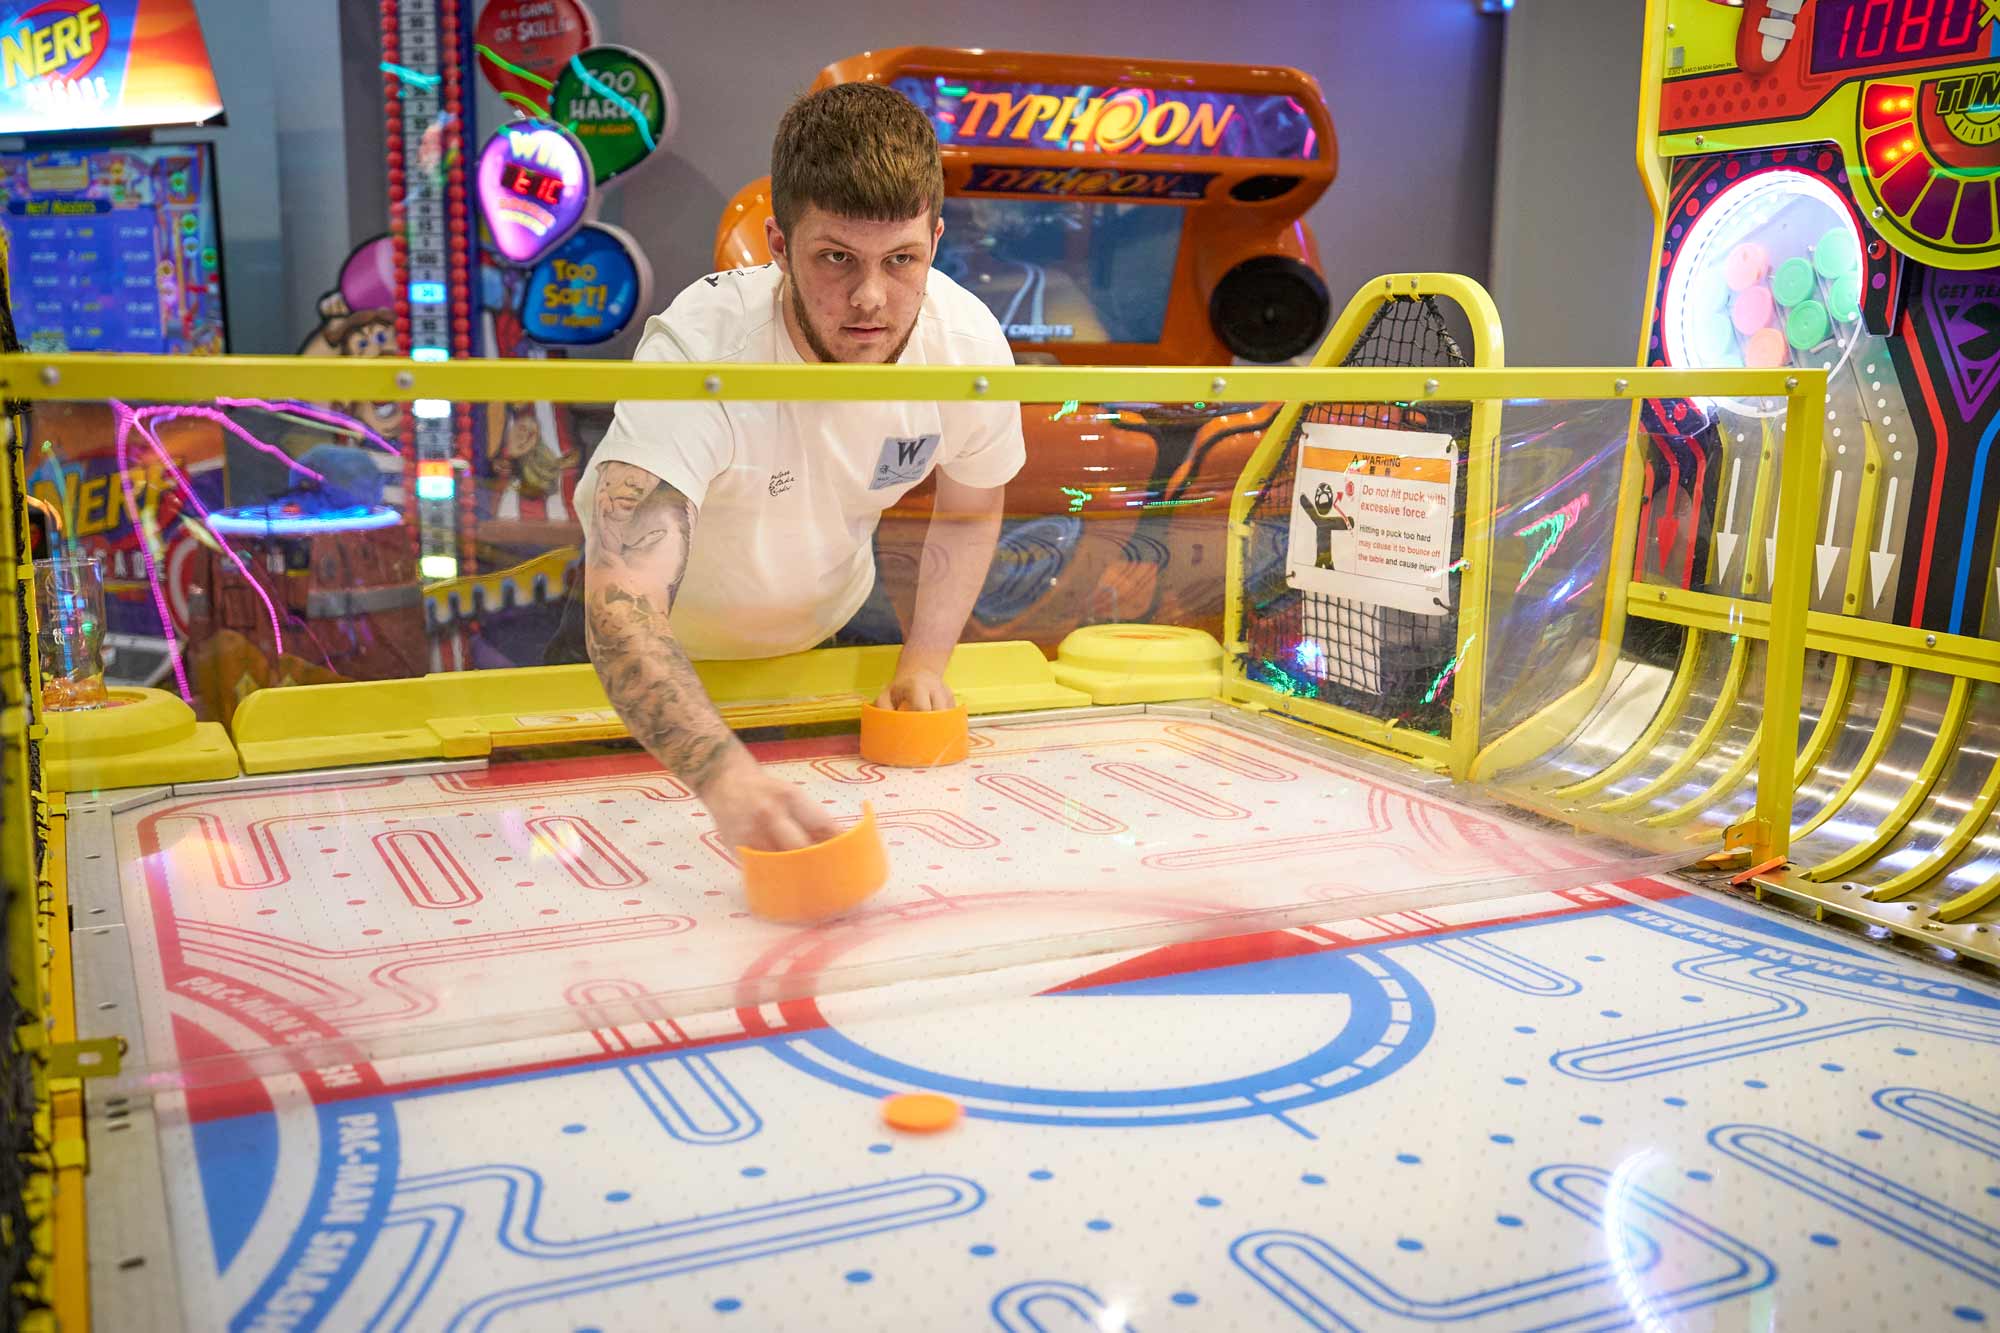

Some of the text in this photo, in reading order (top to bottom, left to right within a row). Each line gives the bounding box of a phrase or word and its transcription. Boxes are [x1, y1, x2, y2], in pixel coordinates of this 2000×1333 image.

[1838, 0, 1977, 60] 1080
[2, 3, 102, 88] NERF
[580, 69, 636, 97] TOO
[569, 91, 650, 120] HARD!
[959, 90, 1235, 150] TYPHOON
[979, 168, 1182, 193] TYPHOON
[552, 260, 597, 281] Too
[1939, 284, 1968, 298] GET
[898, 439, 927, 466] W
[1360, 501, 1400, 516] excessive
[1362, 485, 1447, 506] Do not hit puck with
[1360, 525, 1380, 536] Hitting
[1386, 529, 1401, 539] puck
[1403, 531, 1414, 539] too
[1416, 533, 1431, 542] hard
[1358, 540, 1371, 549] may
[1373, 543, 1391, 551] cause
[1407, 546, 1430, 556] bounce
[1431, 549, 1441, 558] off
[1358, 553, 1368, 561] the
[1369, 554, 1385, 564] table
[1385, 557, 1398, 566] and
[1400, 560, 1418, 569] cause
[1628, 911, 1960, 997] SMASH PAC-MAN
[175, 975, 306, 1032] PAC-MAN
[243, 1112, 381, 1333] PAC-MAN SMASH
